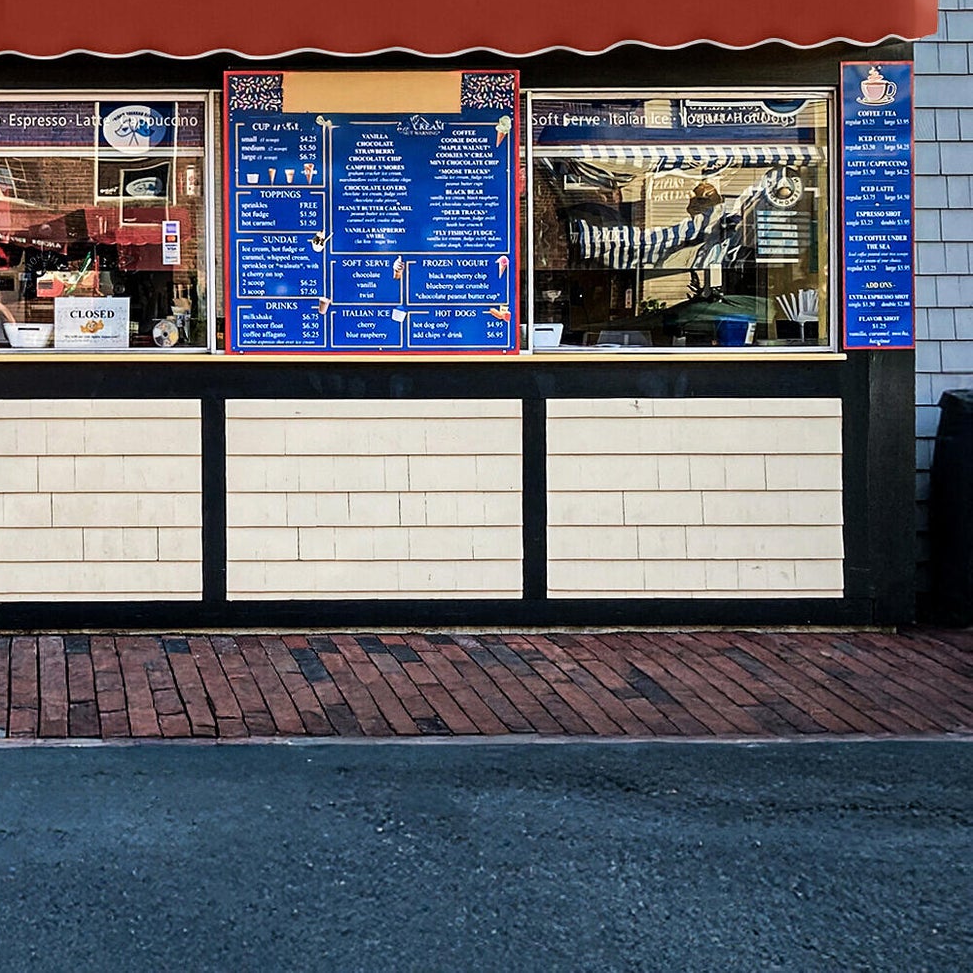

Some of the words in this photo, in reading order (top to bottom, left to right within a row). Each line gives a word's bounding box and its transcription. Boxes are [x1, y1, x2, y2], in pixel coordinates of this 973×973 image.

[9, 113, 67, 129] Espresso
[76, 113, 110, 127] Latte
[119, 113, 198, 130] Cappuccino
[531, 113, 559, 126] Soft
[563, 113, 600, 126] Serve
[609, 113, 645, 126] Italian
[651, 113, 669, 126] Ice
[252, 123, 270, 131] CUP
[241, 153, 256, 161] large
[252, 210, 269, 218] fudge
[265, 302, 298, 310] DRINKS
[70, 310, 115, 318] CLOSED
